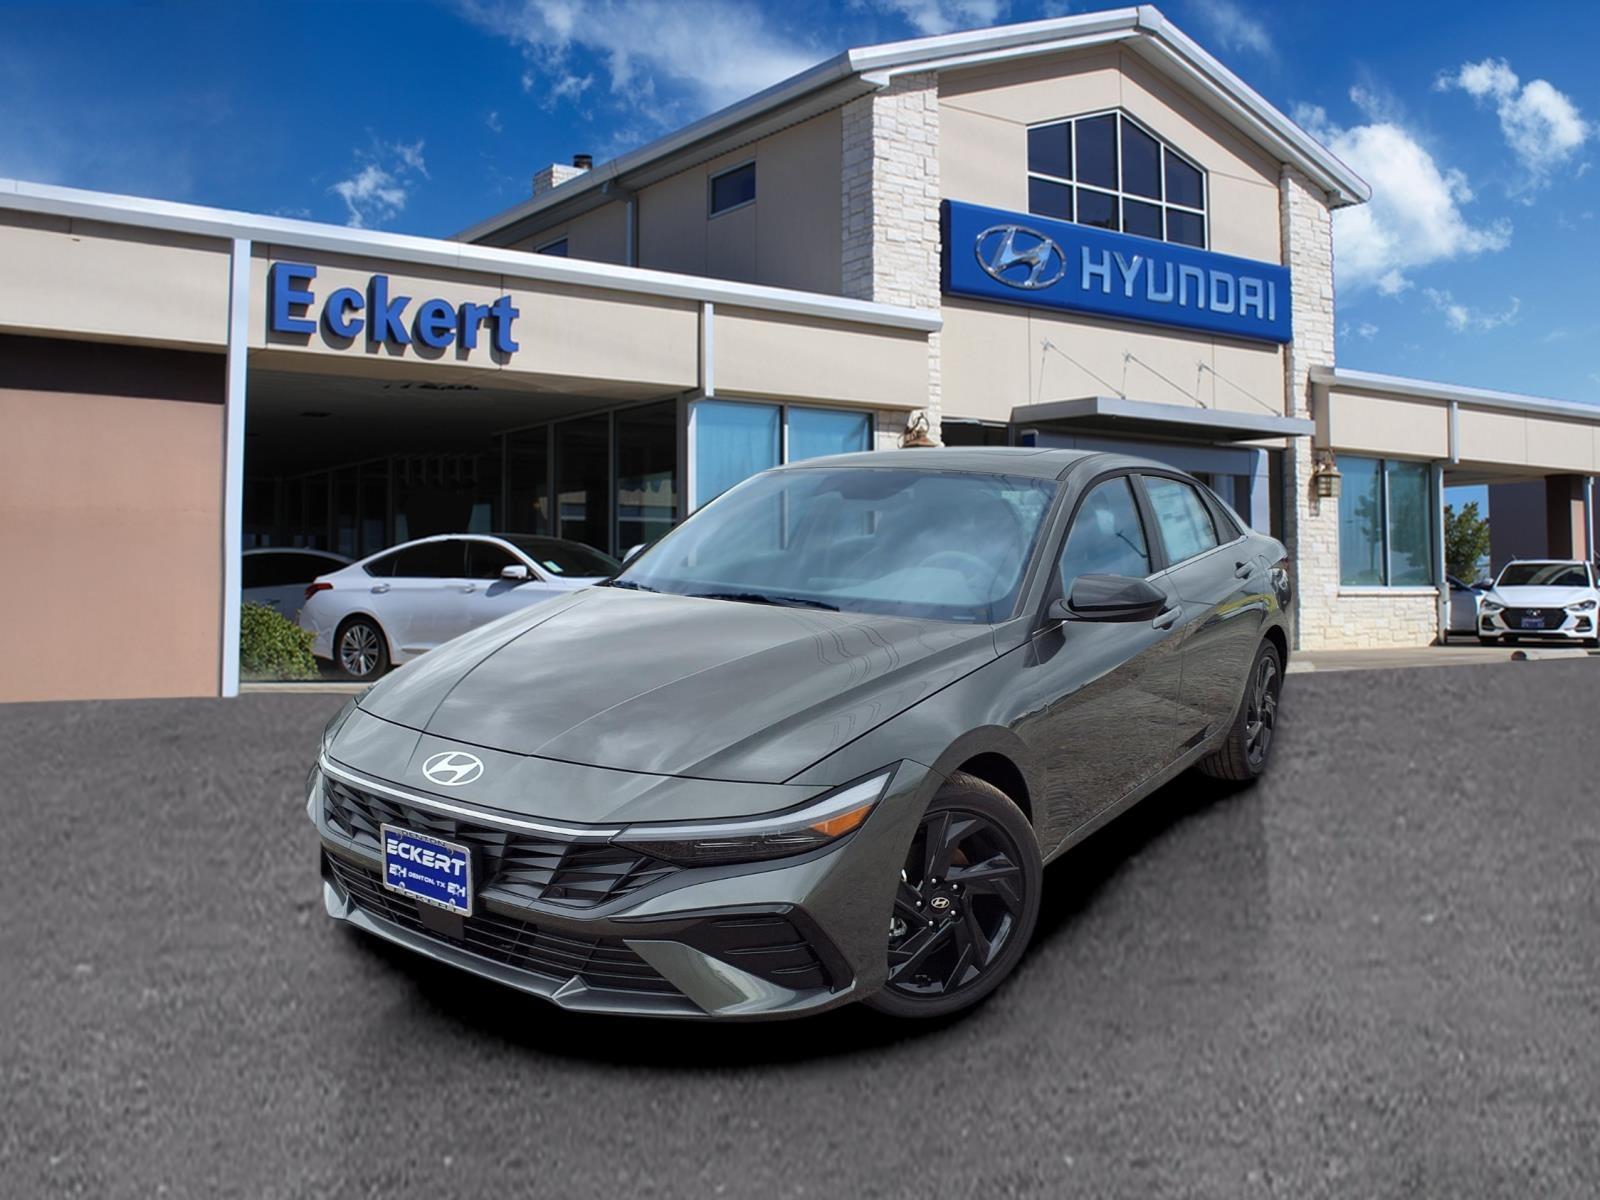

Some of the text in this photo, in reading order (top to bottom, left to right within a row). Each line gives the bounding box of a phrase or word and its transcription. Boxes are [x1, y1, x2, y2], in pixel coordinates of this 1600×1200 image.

[270, 261, 519, 353] Eckert
[1081, 246, 1276, 321] HYUNDAI
[387, 838, 466, 876] ECKERT
[436, 880, 446, 889] TX
